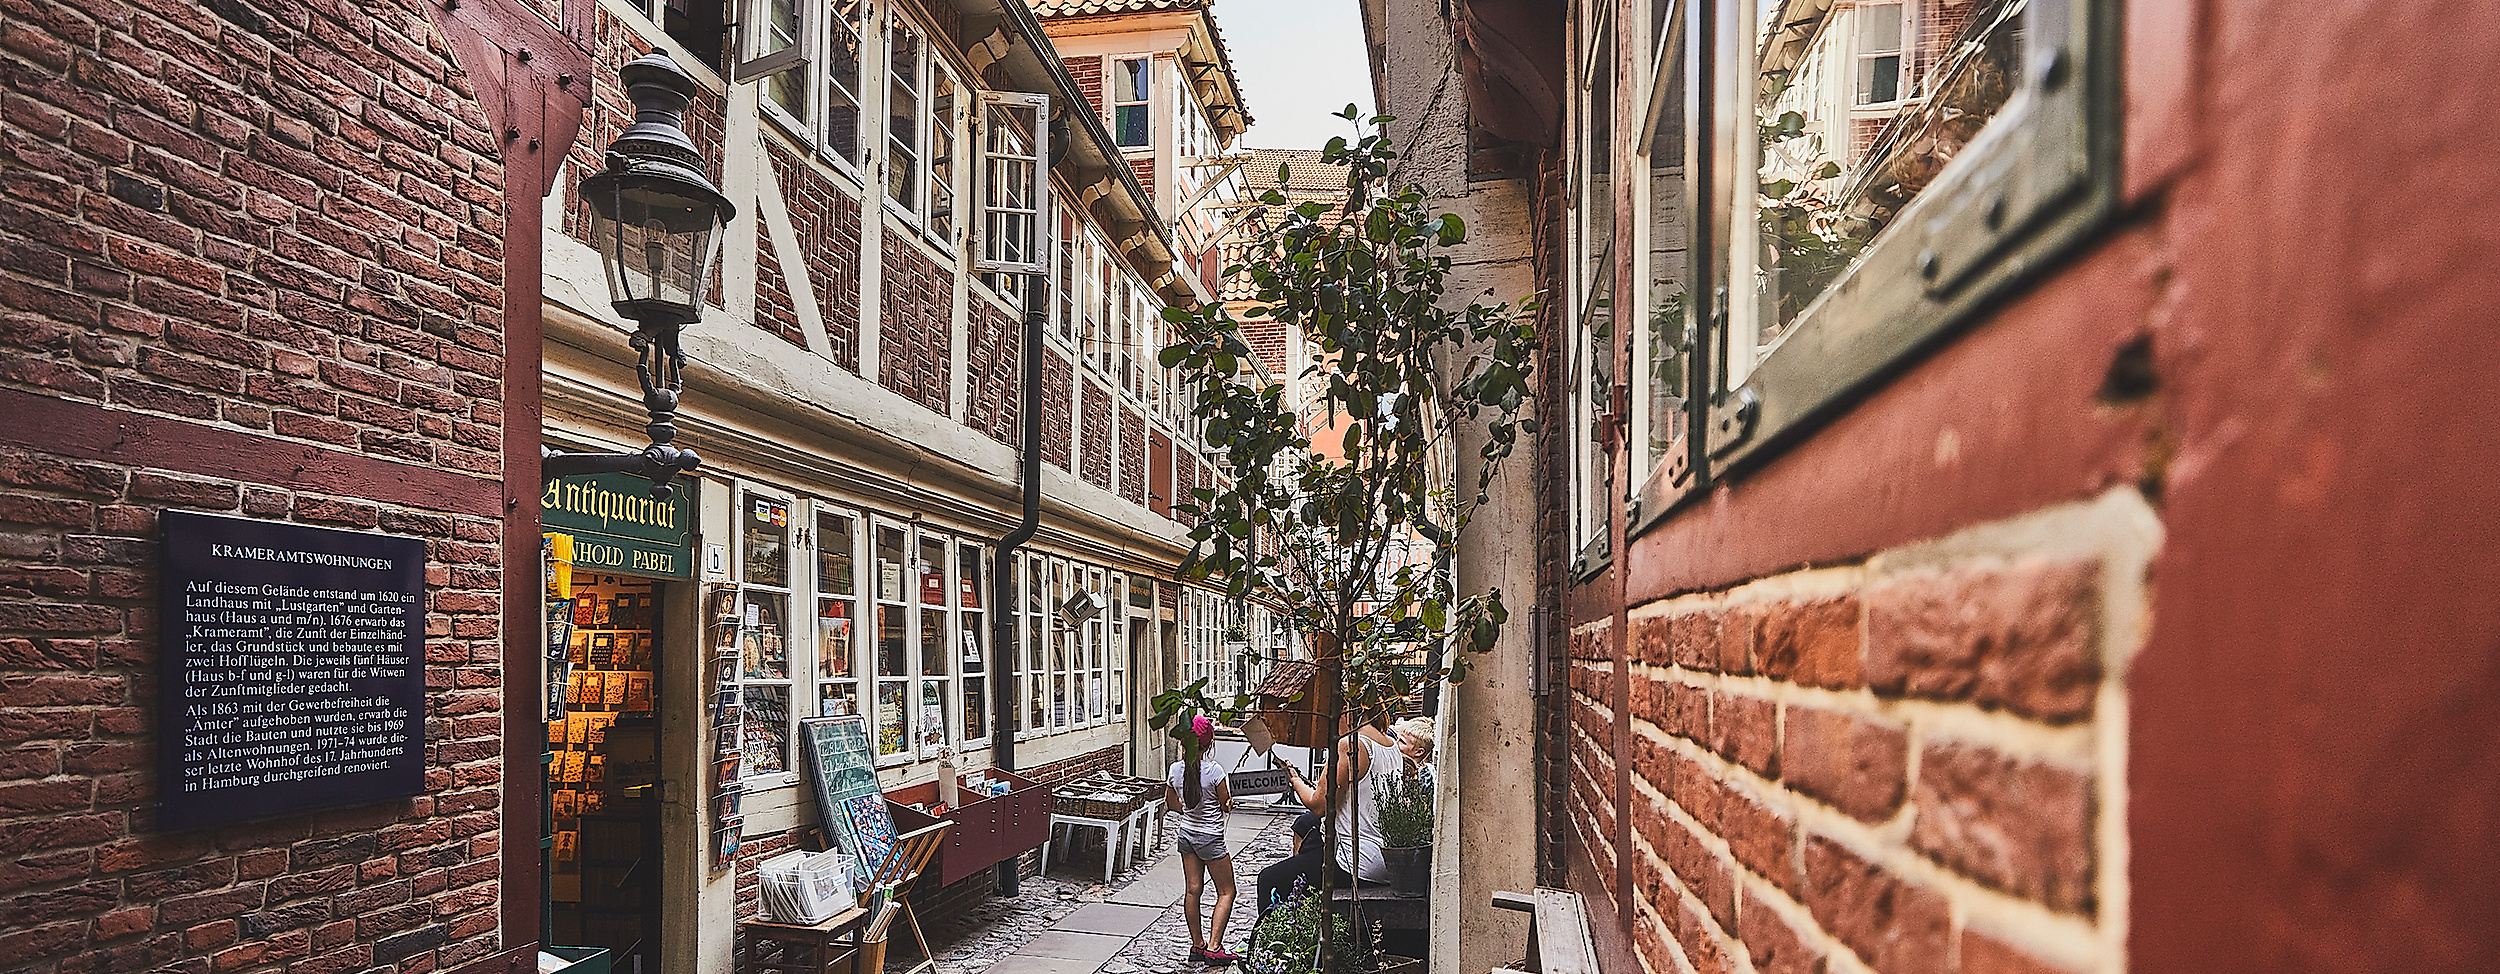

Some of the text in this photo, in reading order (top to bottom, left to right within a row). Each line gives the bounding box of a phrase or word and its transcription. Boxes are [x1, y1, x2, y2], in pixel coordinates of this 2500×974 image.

[541, 478, 676, 529] Antiquariat
[212, 544, 392, 570] KRAMERAMTSWOHNUNGEN
[572, 541, 675, 573] NHOLD PABEL
[712, 547, 720, 570] b
[186, 580, 415, 603] Auf diesem Gelände entstand um 1620 ein
[186, 595, 248, 609] Landhaus
[252, 598, 272, 610] mit
[347, 603, 366, 613] und
[369, 603, 405, 615] Garten-
[186, 610, 405, 628] haus (Haus a und m/n). 1676 erwarb das
[275, 627, 293, 639] die
[296, 627, 327, 639] Zunft
[330, 628, 347, 639] der
[350, 628, 406, 640] Einzelhänd-
[186, 640, 402, 653] ler, das Grundstück und bebaute es mit
[186, 654, 409, 669] zwei Hofflügeln. Die jeweils fünf Häuser
[185, 667, 405, 684] (Haus b-f und g-l) waren für die Witwen
[185, 681, 352, 697] der Zunftmitglieder gedacht.
[186, 695, 390, 719] Als 1863 mit der Gewerbefreiheit die
[243, 714, 310, 729] aufgehoben
[314, 711, 356, 723] wurden,
[358, 708, 391, 720] erwarb
[393, 707, 407, 718] die
[185, 719, 404, 746] Stadt die Bauten und nutzte sie bis 1969
[184, 749, 202, 762] als
[207, 742, 313, 760] Altenwohnungen.
[358, 734, 388, 745] wurde
[390, 732, 408, 743] die-
[185, 746, 403, 777] ser letzte Wohnhof des 17. Jahrhunderts
[185, 760, 390, 792] in Hamburg durchgreifend renoviert.
[1232, 776, 1287, 789] WELCOME
